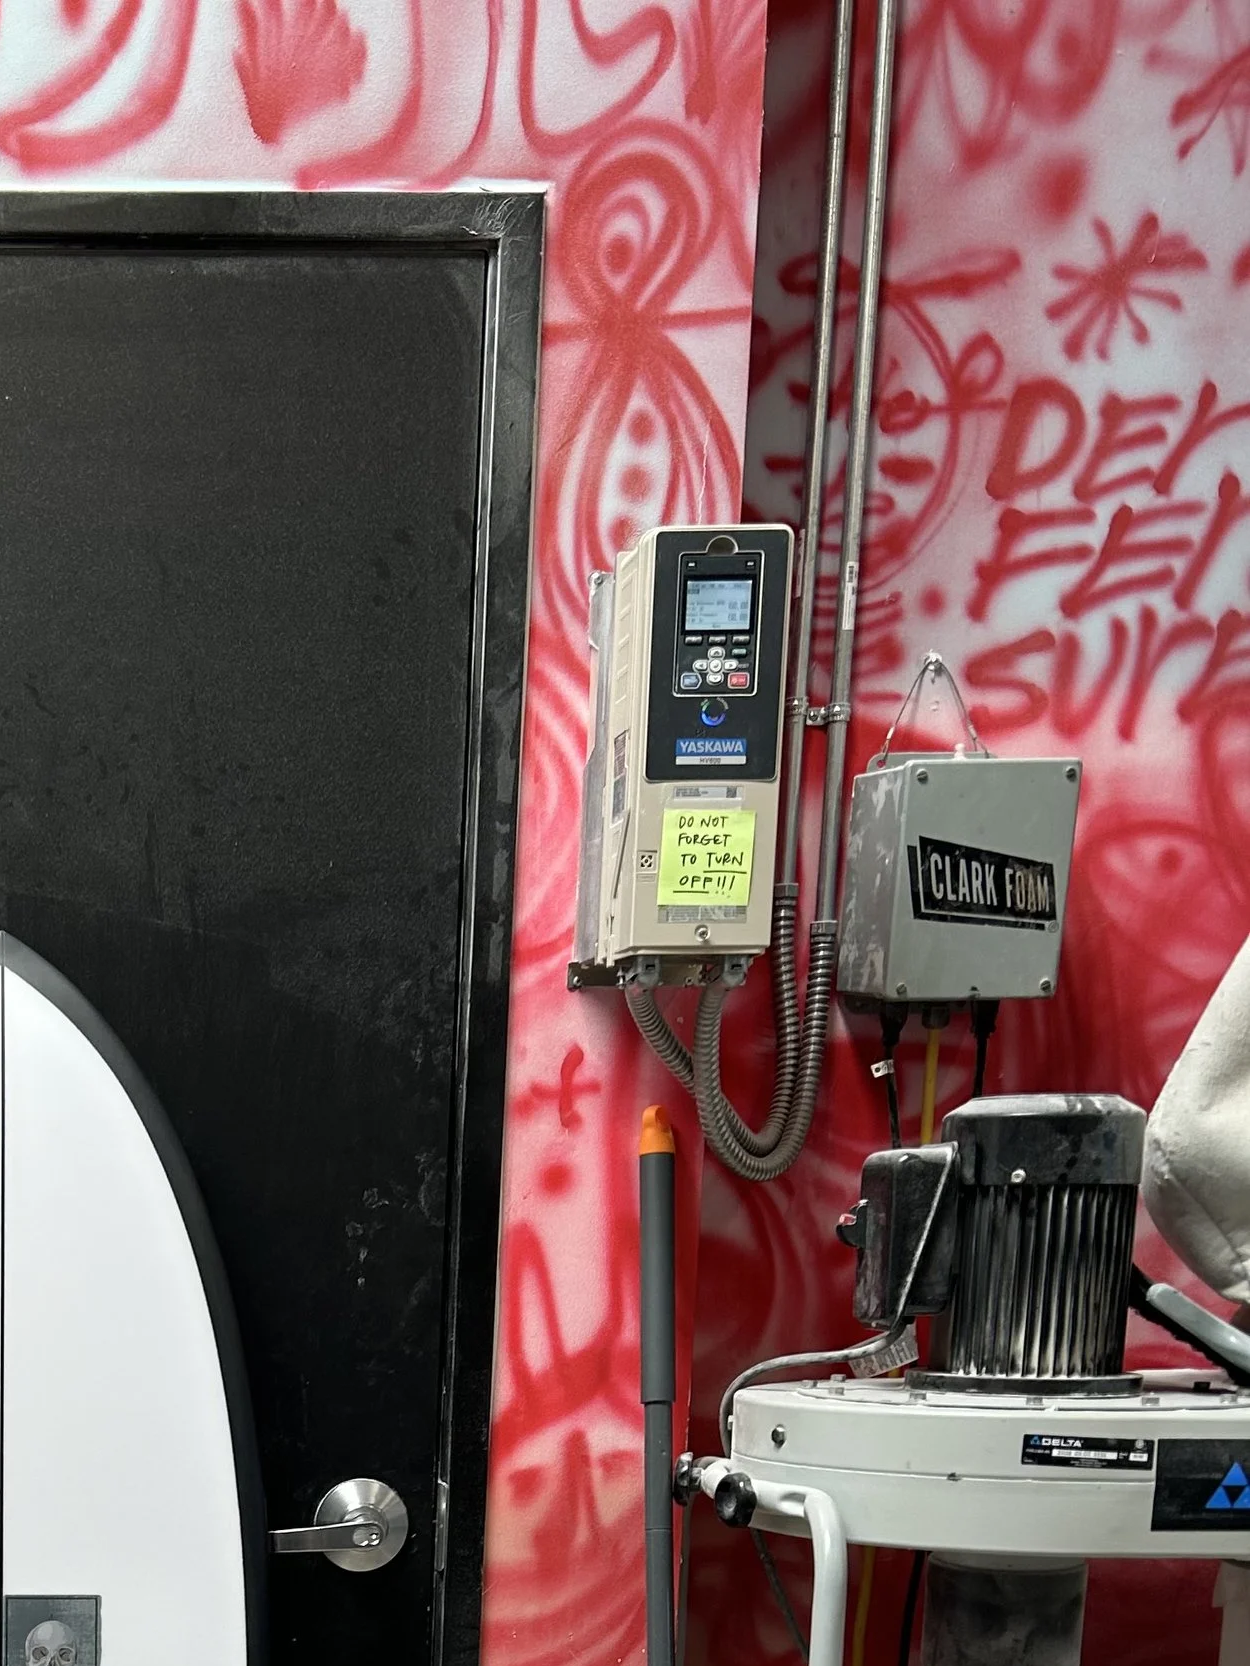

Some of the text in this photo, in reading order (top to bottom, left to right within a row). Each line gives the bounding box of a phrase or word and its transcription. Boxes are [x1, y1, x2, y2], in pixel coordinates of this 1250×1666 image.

[679, 740, 744, 753] YASKAWA
[678, 814, 729, 829] DO NOT
[678, 832, 732, 847] FORGET
[680, 851, 744, 869] TO TURN
[929, 852, 1051, 913] CLARK FOAM
[1041, 1436, 1083, 1448] DELTA
